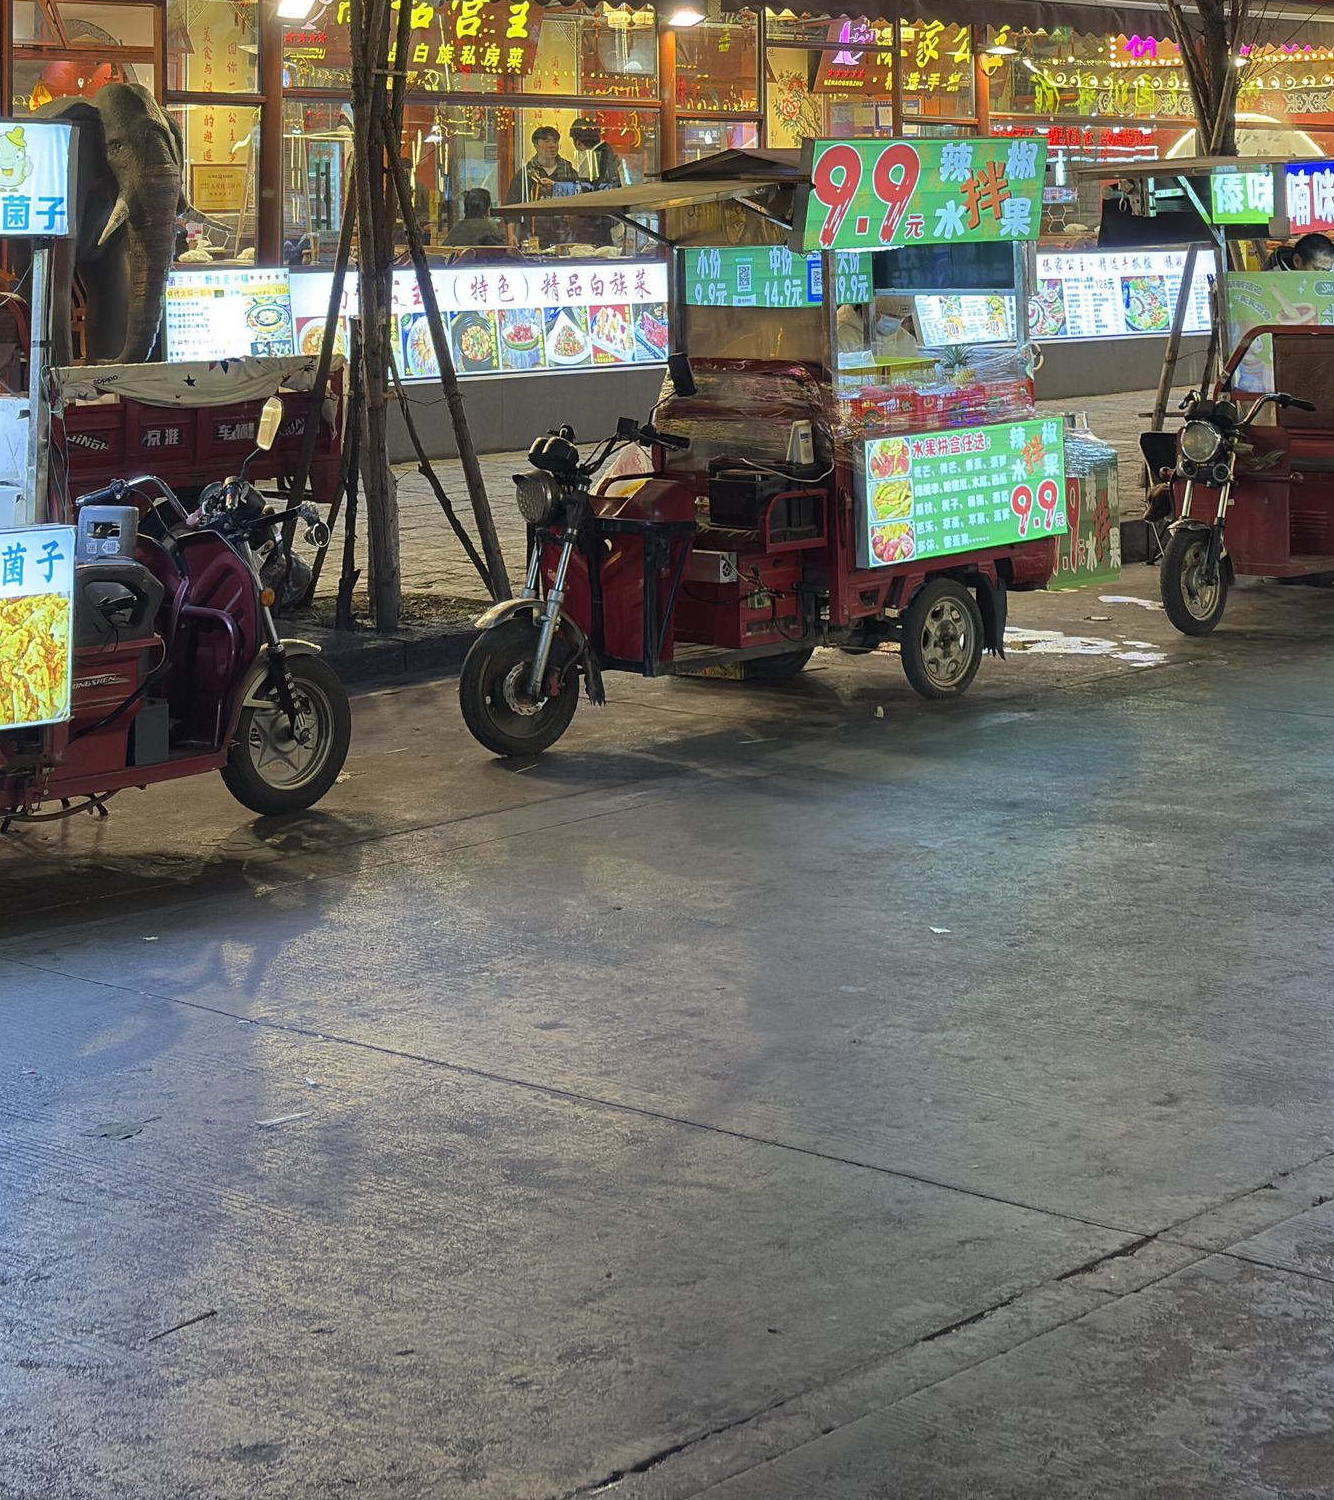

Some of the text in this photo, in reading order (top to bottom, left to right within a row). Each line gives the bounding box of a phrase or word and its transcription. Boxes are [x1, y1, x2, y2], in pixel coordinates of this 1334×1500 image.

[387, 43, 525, 70] 白族私房菜
[202, 27, 215, 163] 美食与汉的邂逅
[939, 141, 1038, 182] 辣椒
[814, 142, 924, 249] 9.9元
[960, 160, 1010, 228] 拌
[933, 197, 1033, 240] 水果
[696, 248, 722, 279] 小份
[769, 246, 793, 276] 中份
[695, 283, 728, 306] 9.9元
[764, 278, 803, 308] 14.9元
[1009, 422, 1058, 450] 辣椒
[1010, 453, 1060, 483] 水果
[1021, 435, 1046, 475] 拌
[1010, 477, 1066, 538] 9.9元
[70, 674, 118, 690] ONGSHEN
